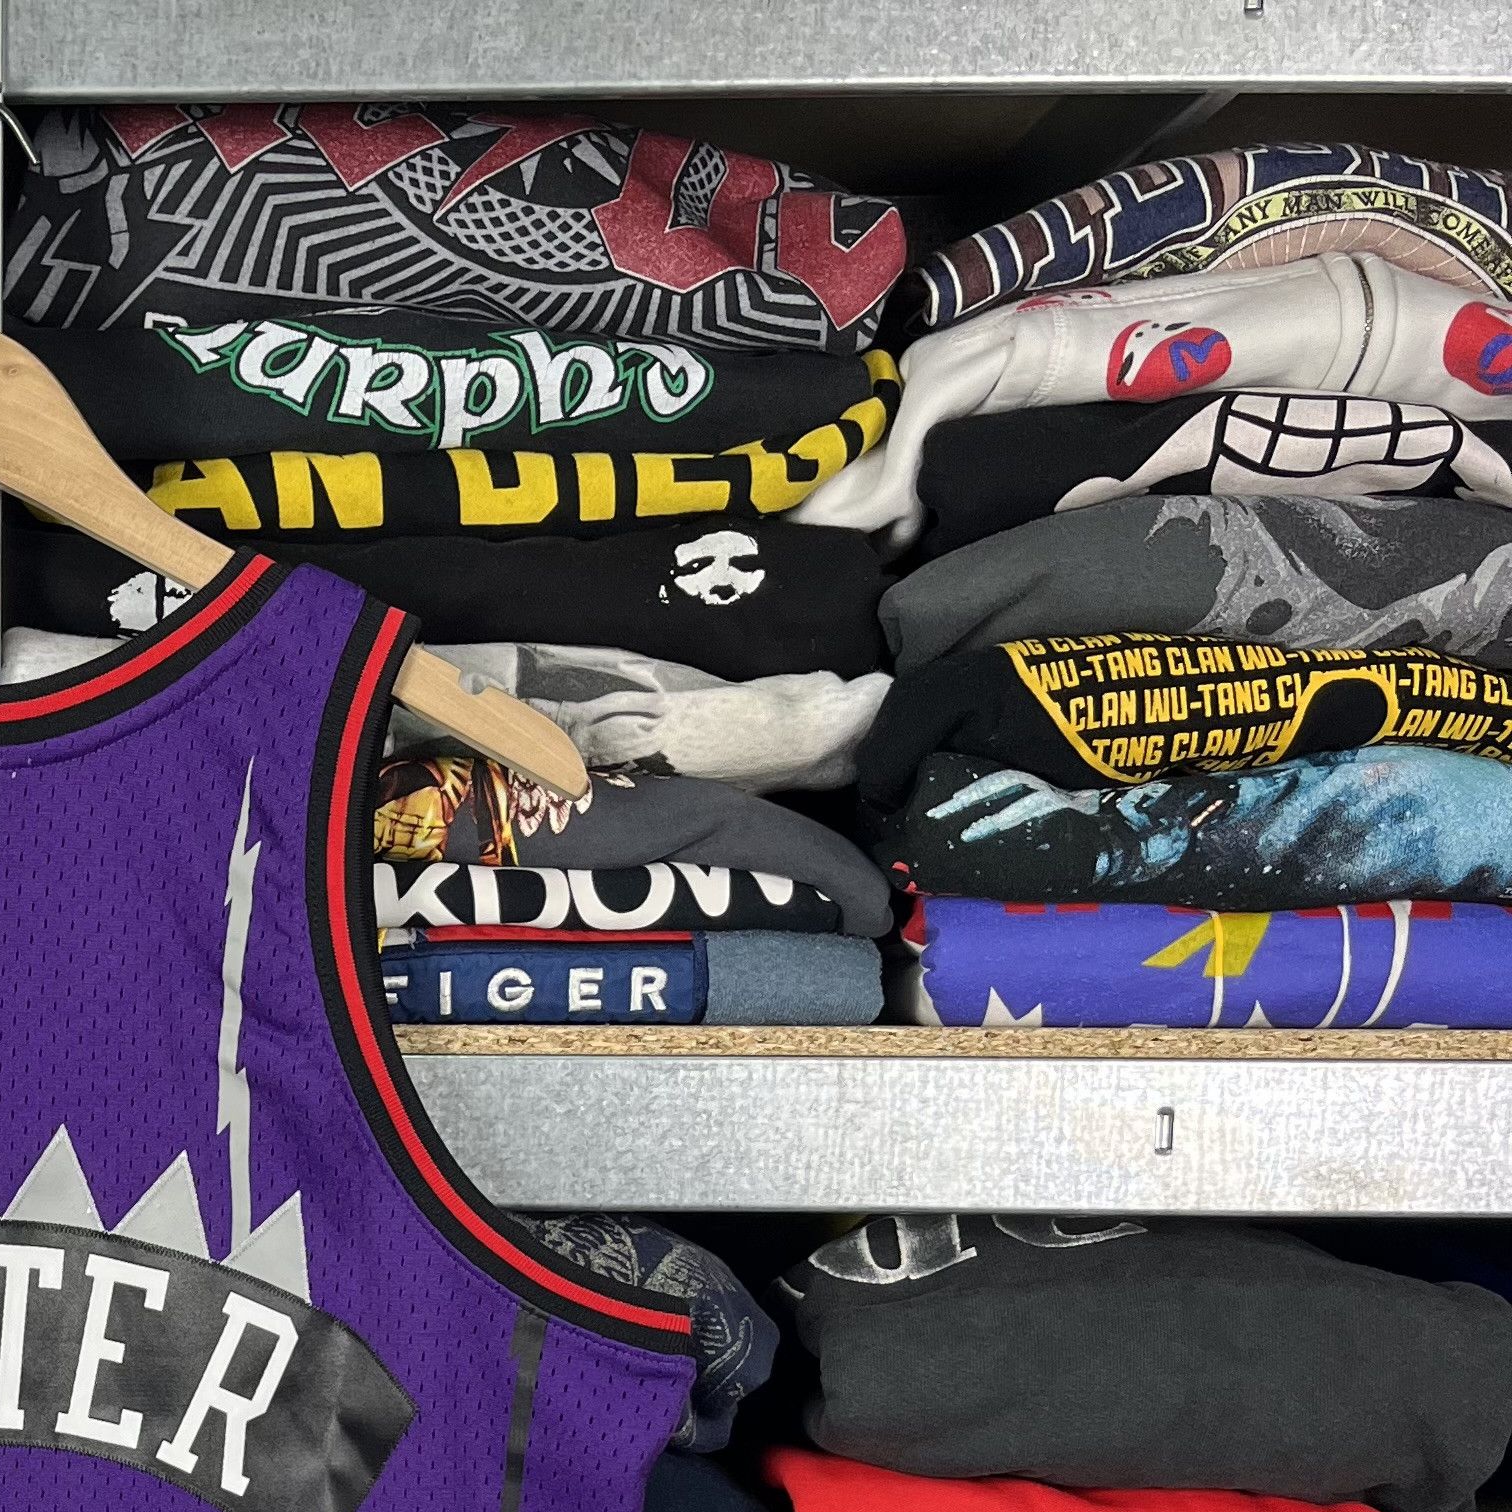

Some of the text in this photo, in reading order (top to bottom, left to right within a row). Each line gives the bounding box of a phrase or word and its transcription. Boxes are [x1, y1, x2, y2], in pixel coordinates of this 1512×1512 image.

[1220, 197, 1273, 242] ANY
[1280, 190, 1347, 217] MAN
[1352, 189, 1416, 213] WILL
[140, 450, 384, 530] AN
[1032, 647, 1162, 692] WU-TANG
[1166, 646, 1235, 676] CLAN
[1069, 689, 1136, 732] CLAN
[1144, 679, 1270, 724] WU-TANG
[1091, 735, 1165, 768] TANG
[1170, 726, 1243, 762] CLAN
[374, 862, 831, 930] KDOW
